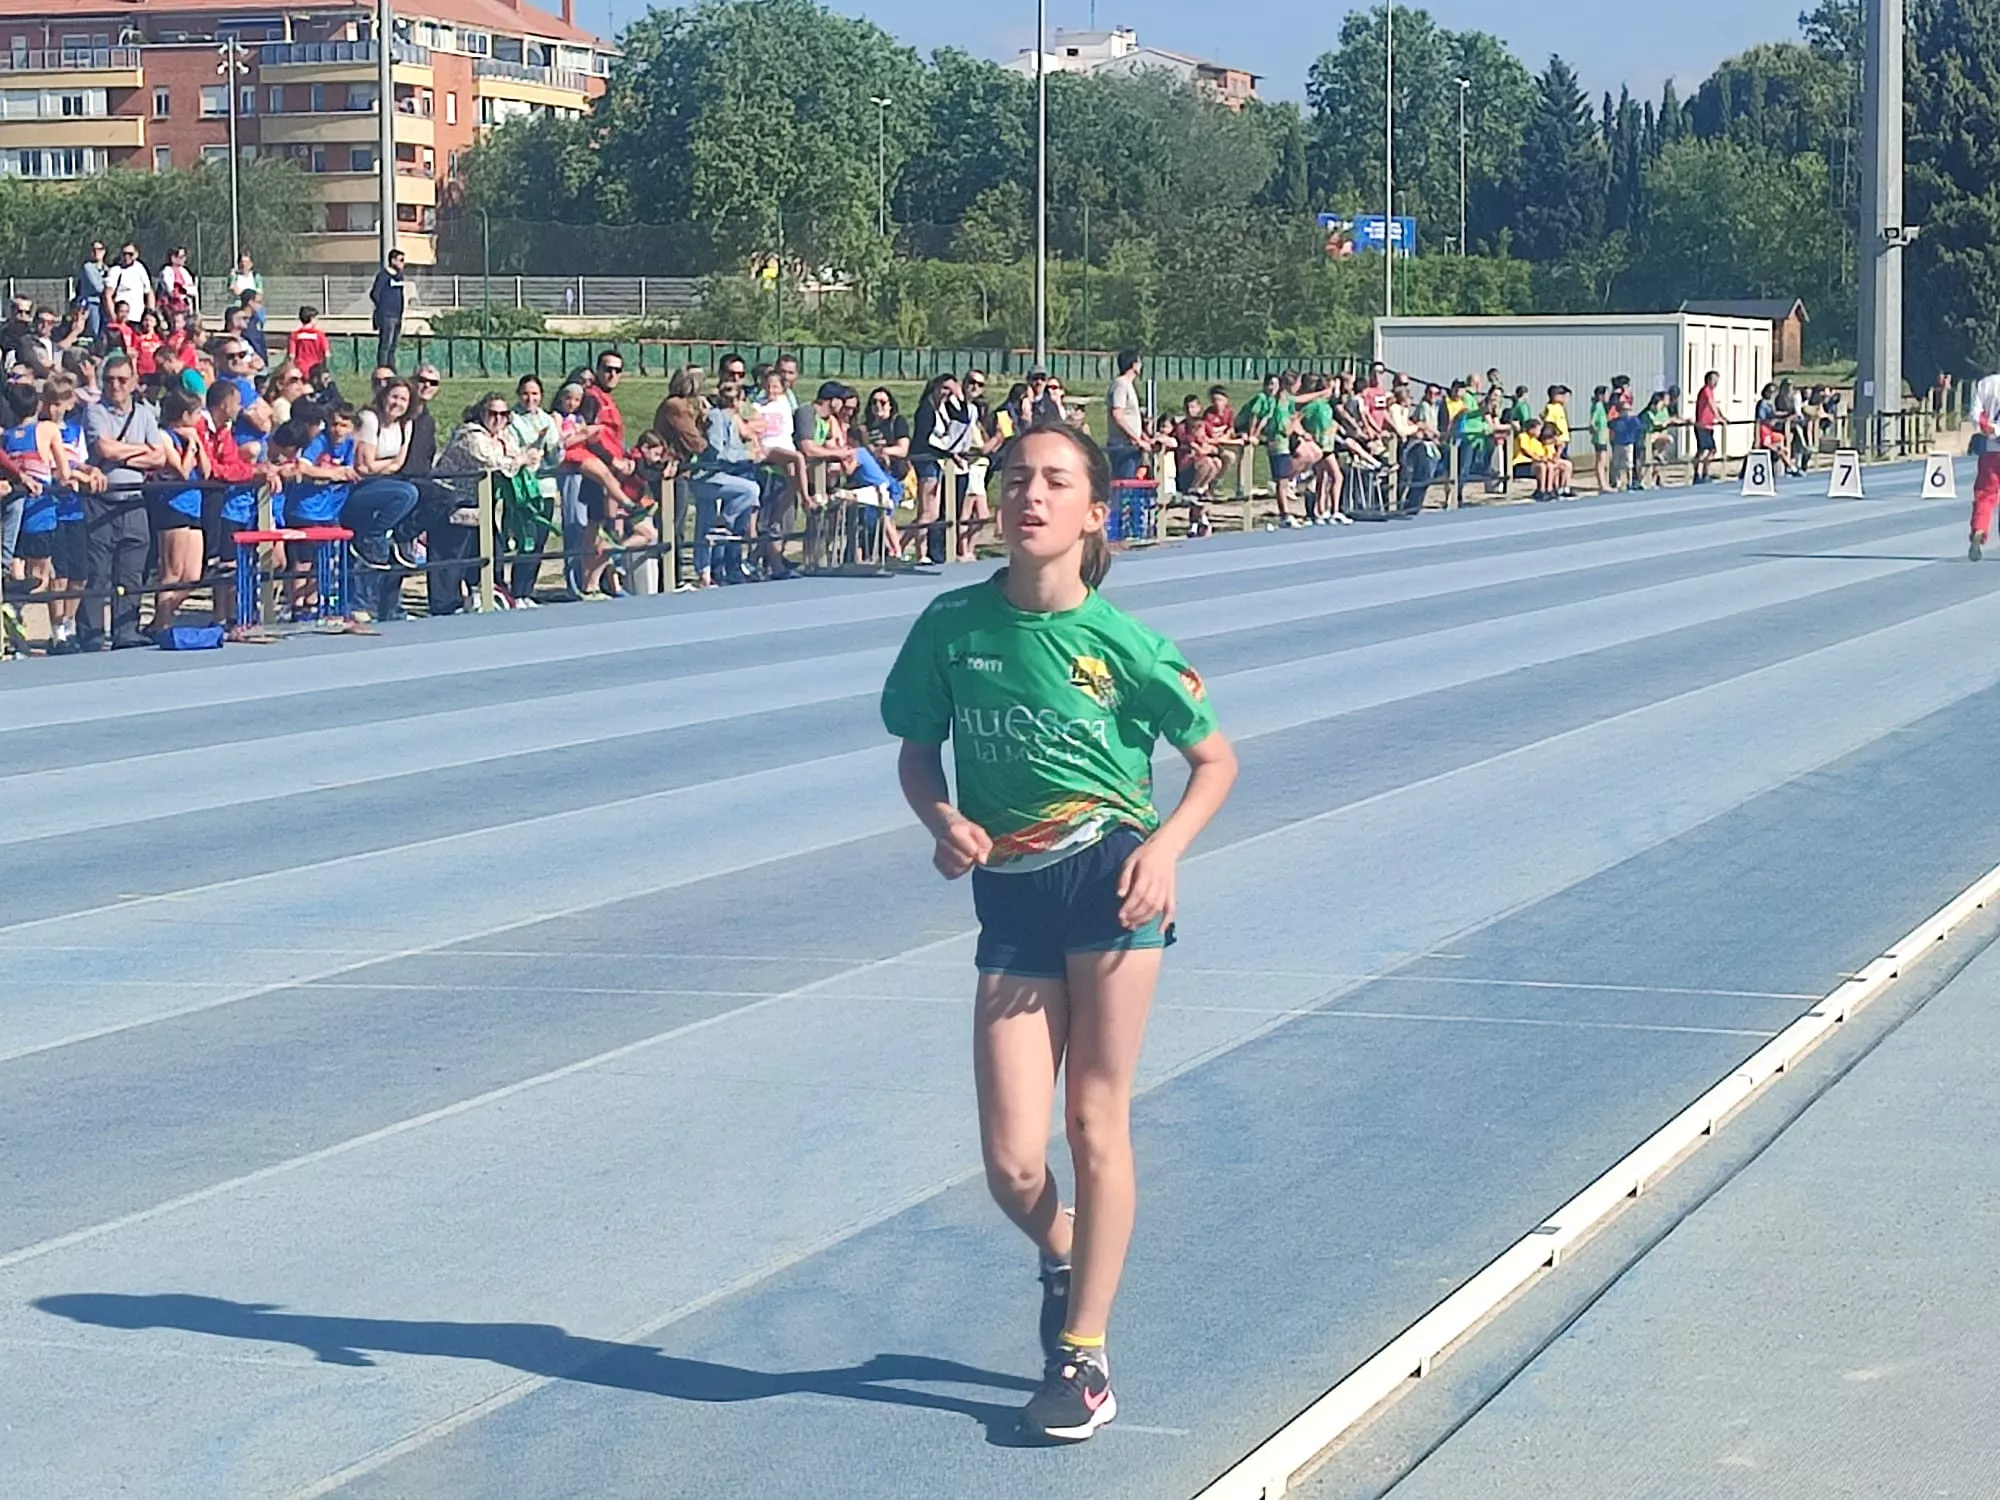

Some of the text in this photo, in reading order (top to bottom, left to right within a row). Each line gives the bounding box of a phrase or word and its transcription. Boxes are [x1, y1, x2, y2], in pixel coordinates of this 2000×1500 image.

[1752, 463, 1766, 486] 8
[1840, 464, 1852, 486] 7
[1930, 465, 1946, 488] 6
